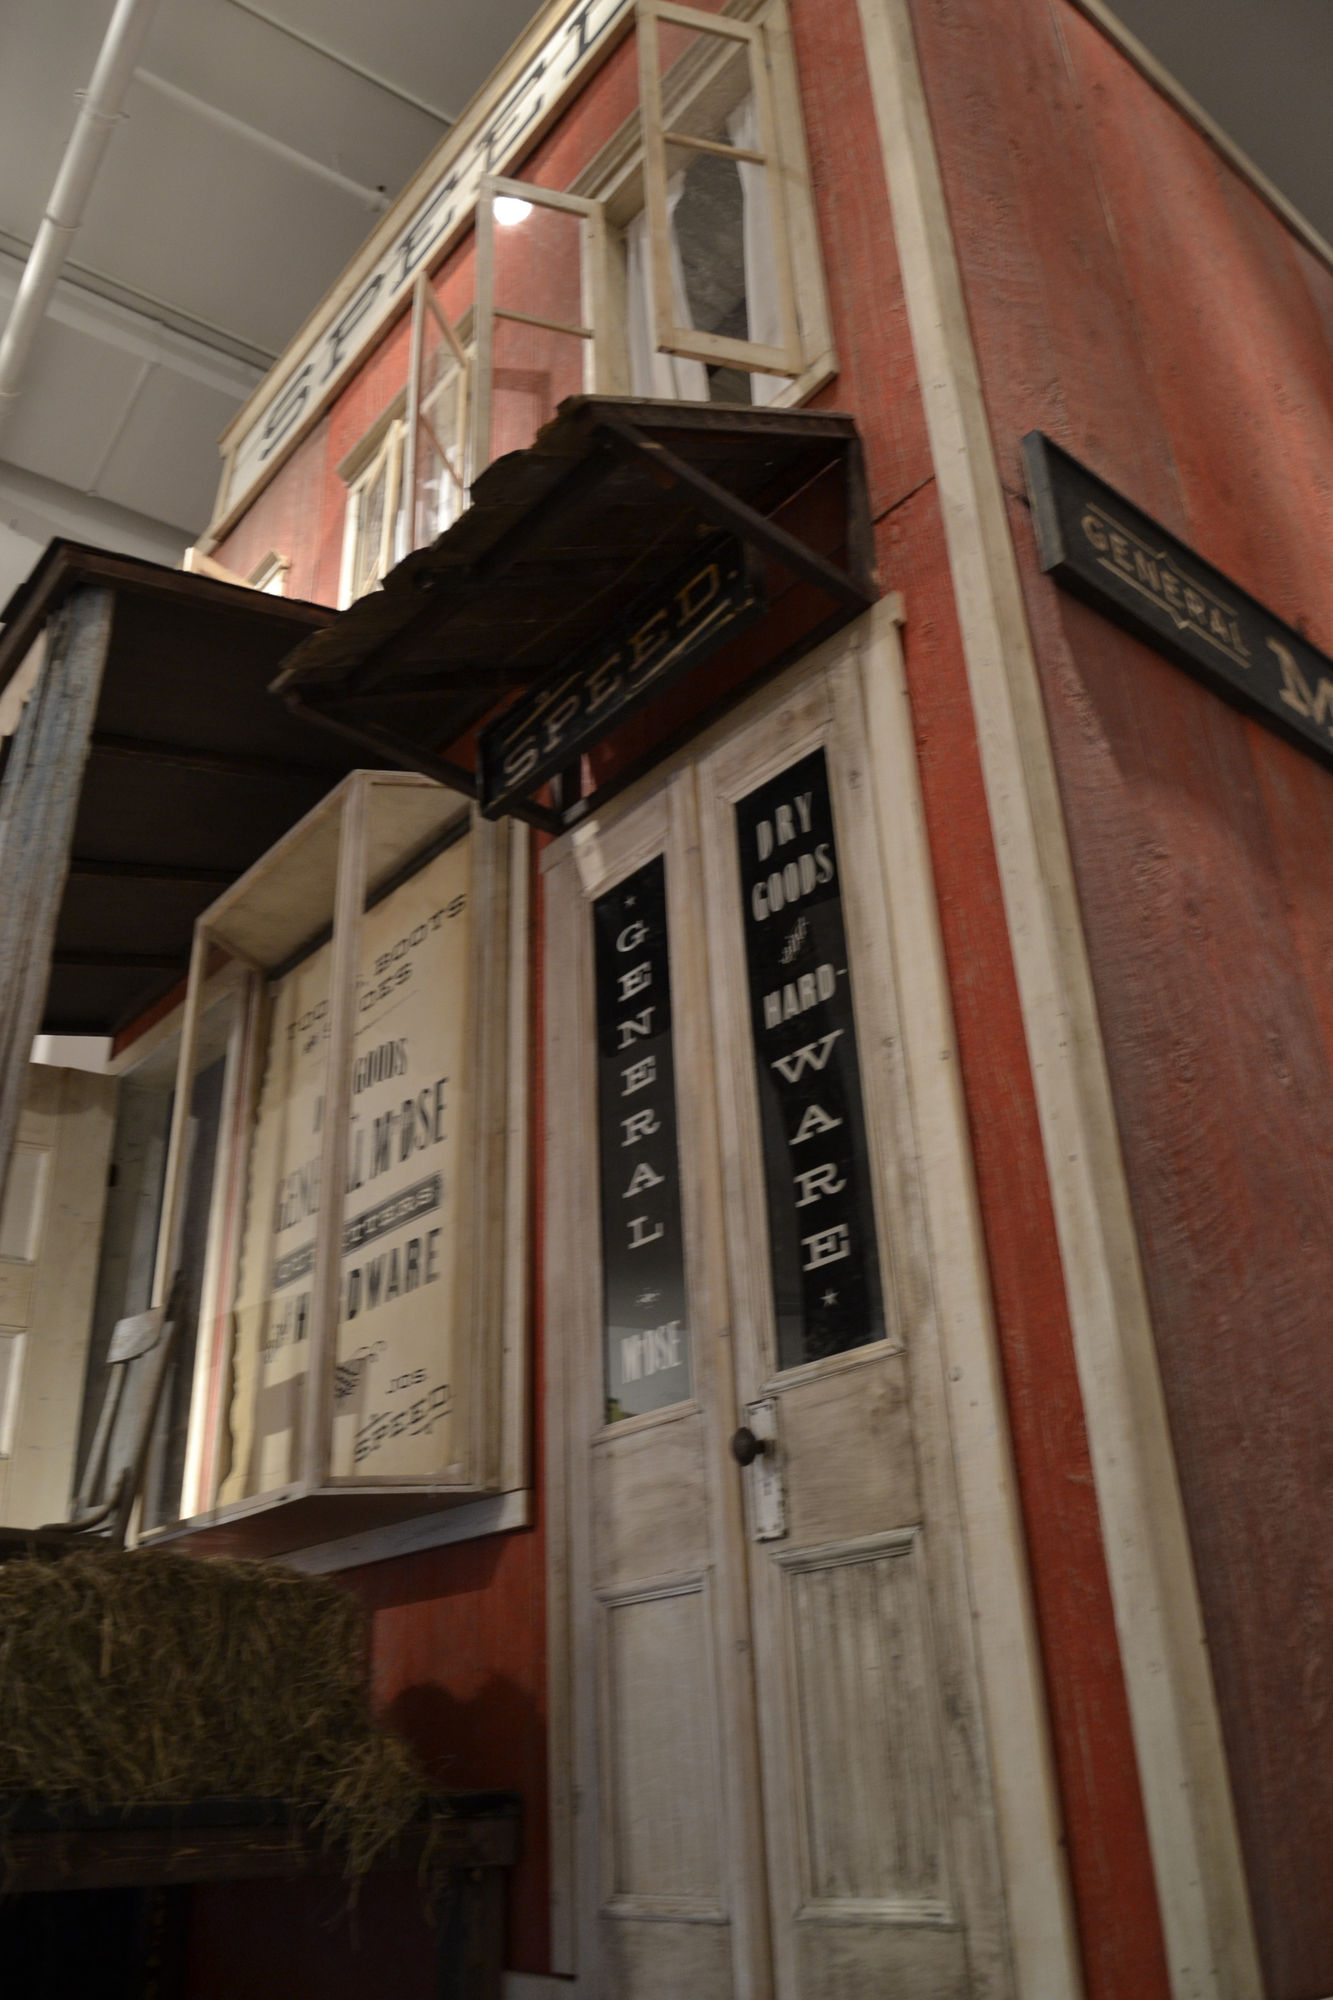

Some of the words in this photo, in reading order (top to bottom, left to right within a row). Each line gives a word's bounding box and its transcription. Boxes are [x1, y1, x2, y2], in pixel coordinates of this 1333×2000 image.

[1081, 513, 1250, 657] GENERAL
[755, 791, 812, 862] DRY
[752, 843, 834, 922] GOODS
[374, 893, 467, 976] BOOTS
[323, 962, 413, 1040] SOES
[616, 919, 665, 1250] GENERAL
[771, 1028, 850, 1272] WARE
[294, 1226, 443, 1344] HDWARE
